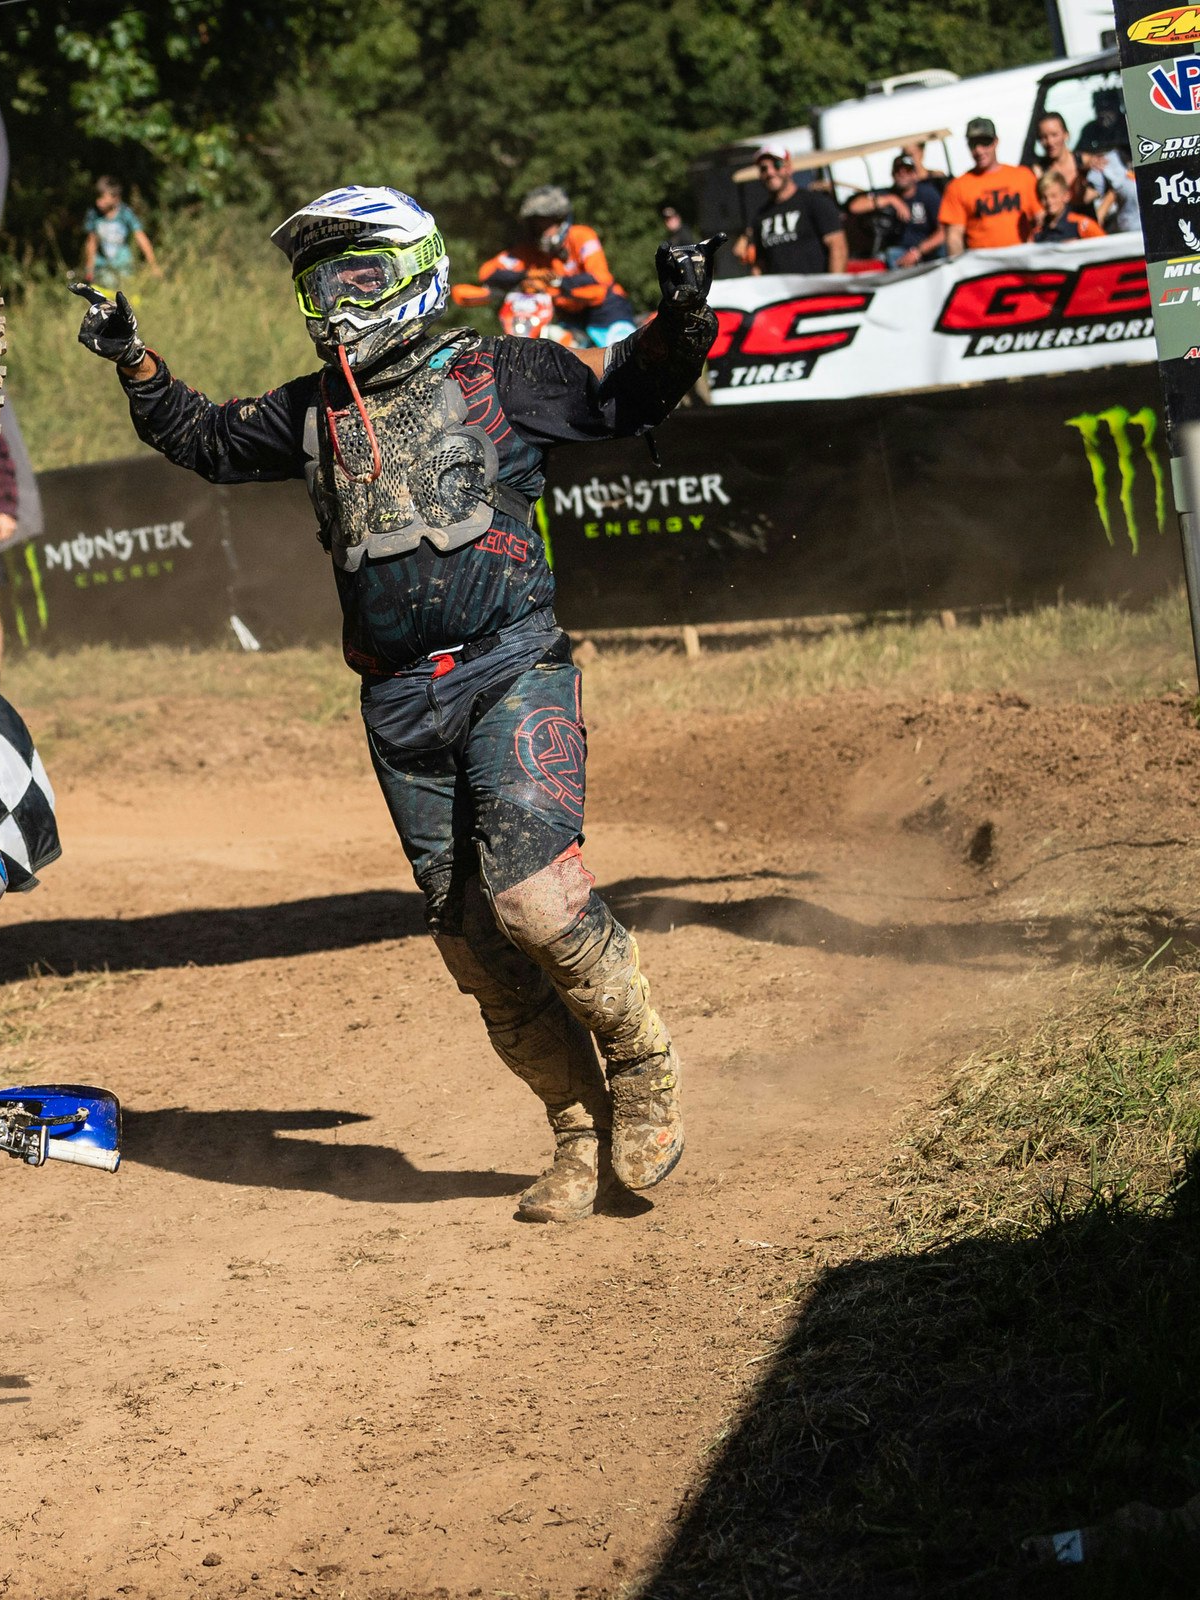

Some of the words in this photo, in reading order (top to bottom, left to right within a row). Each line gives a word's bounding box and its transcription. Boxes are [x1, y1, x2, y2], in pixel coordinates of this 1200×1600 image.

[1163, 135, 1200, 151] DU
[974, 190, 1021, 219] KTM
[304, 221, 360, 244] METHOD
[761, 210, 801, 241] FLY
[730, 360, 805, 387] TIRES
[553, 474, 731, 518] MONSTER
[584, 514, 705, 539] ENERGY
[44, 521, 192, 571] MONSTER
